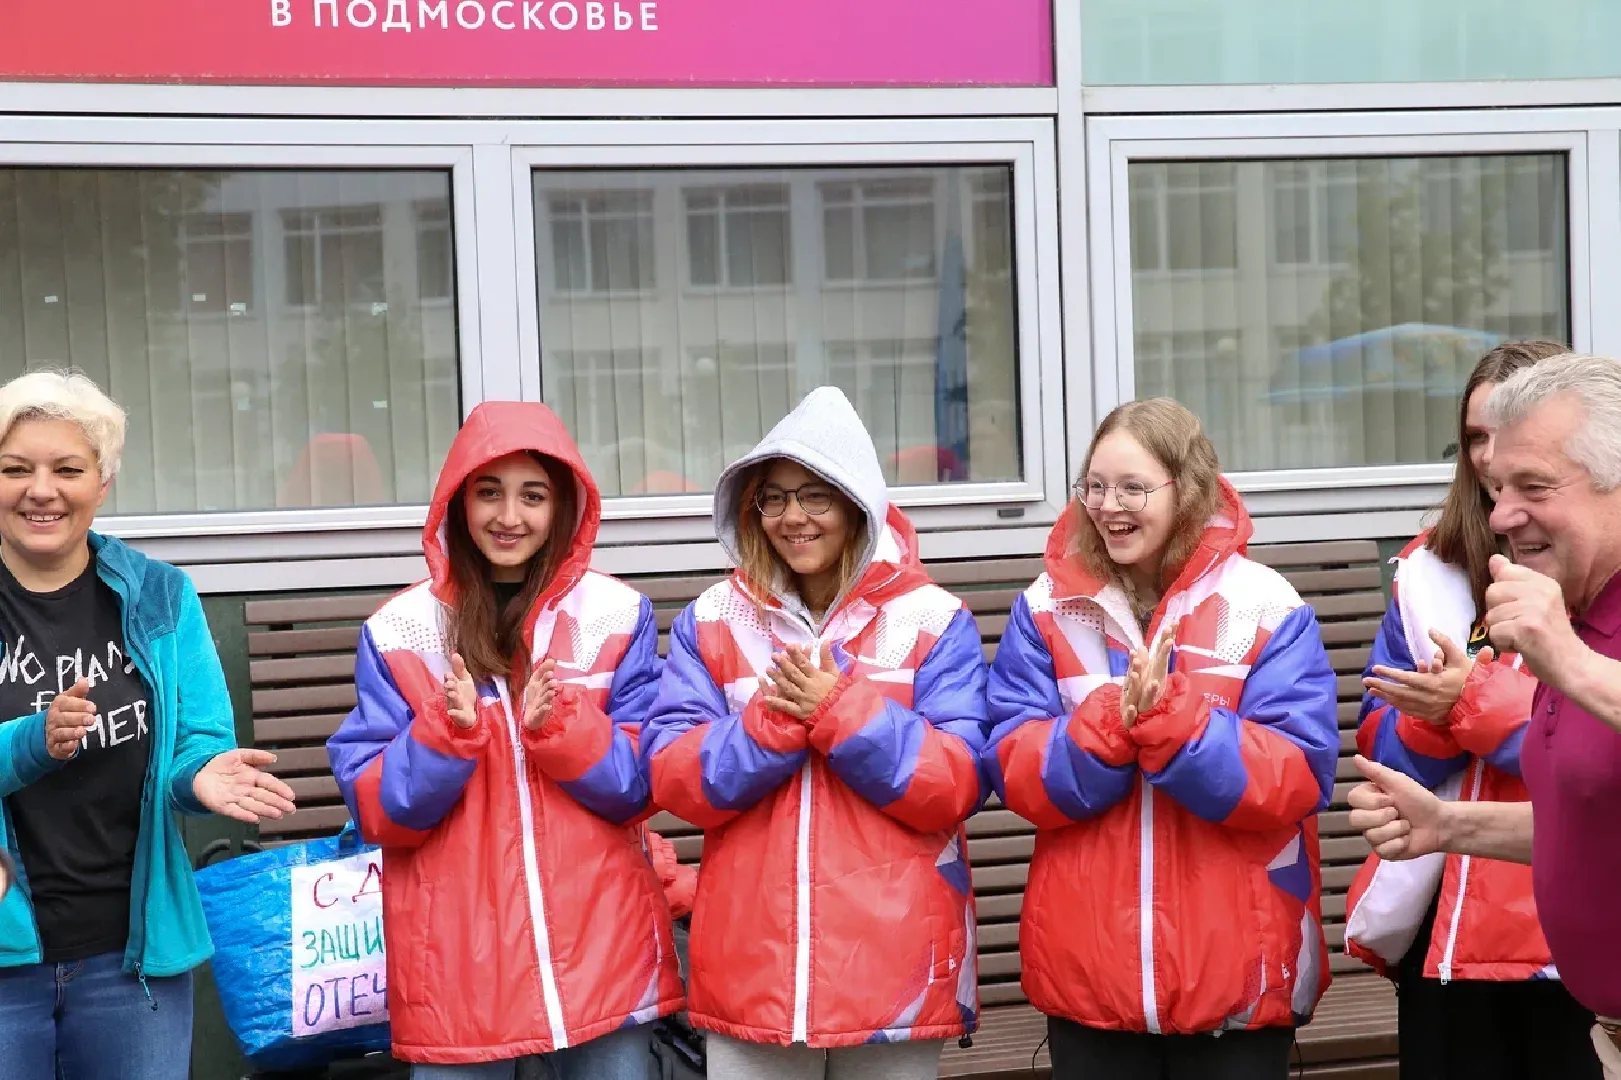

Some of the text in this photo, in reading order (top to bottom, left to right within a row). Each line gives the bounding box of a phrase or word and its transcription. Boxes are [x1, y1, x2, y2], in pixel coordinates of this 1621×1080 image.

[271, 0, 659, 32] В ПОДМОСКОВЬЕ
[0, 634, 46, 685] NO
[314, 872, 338, 909] С
